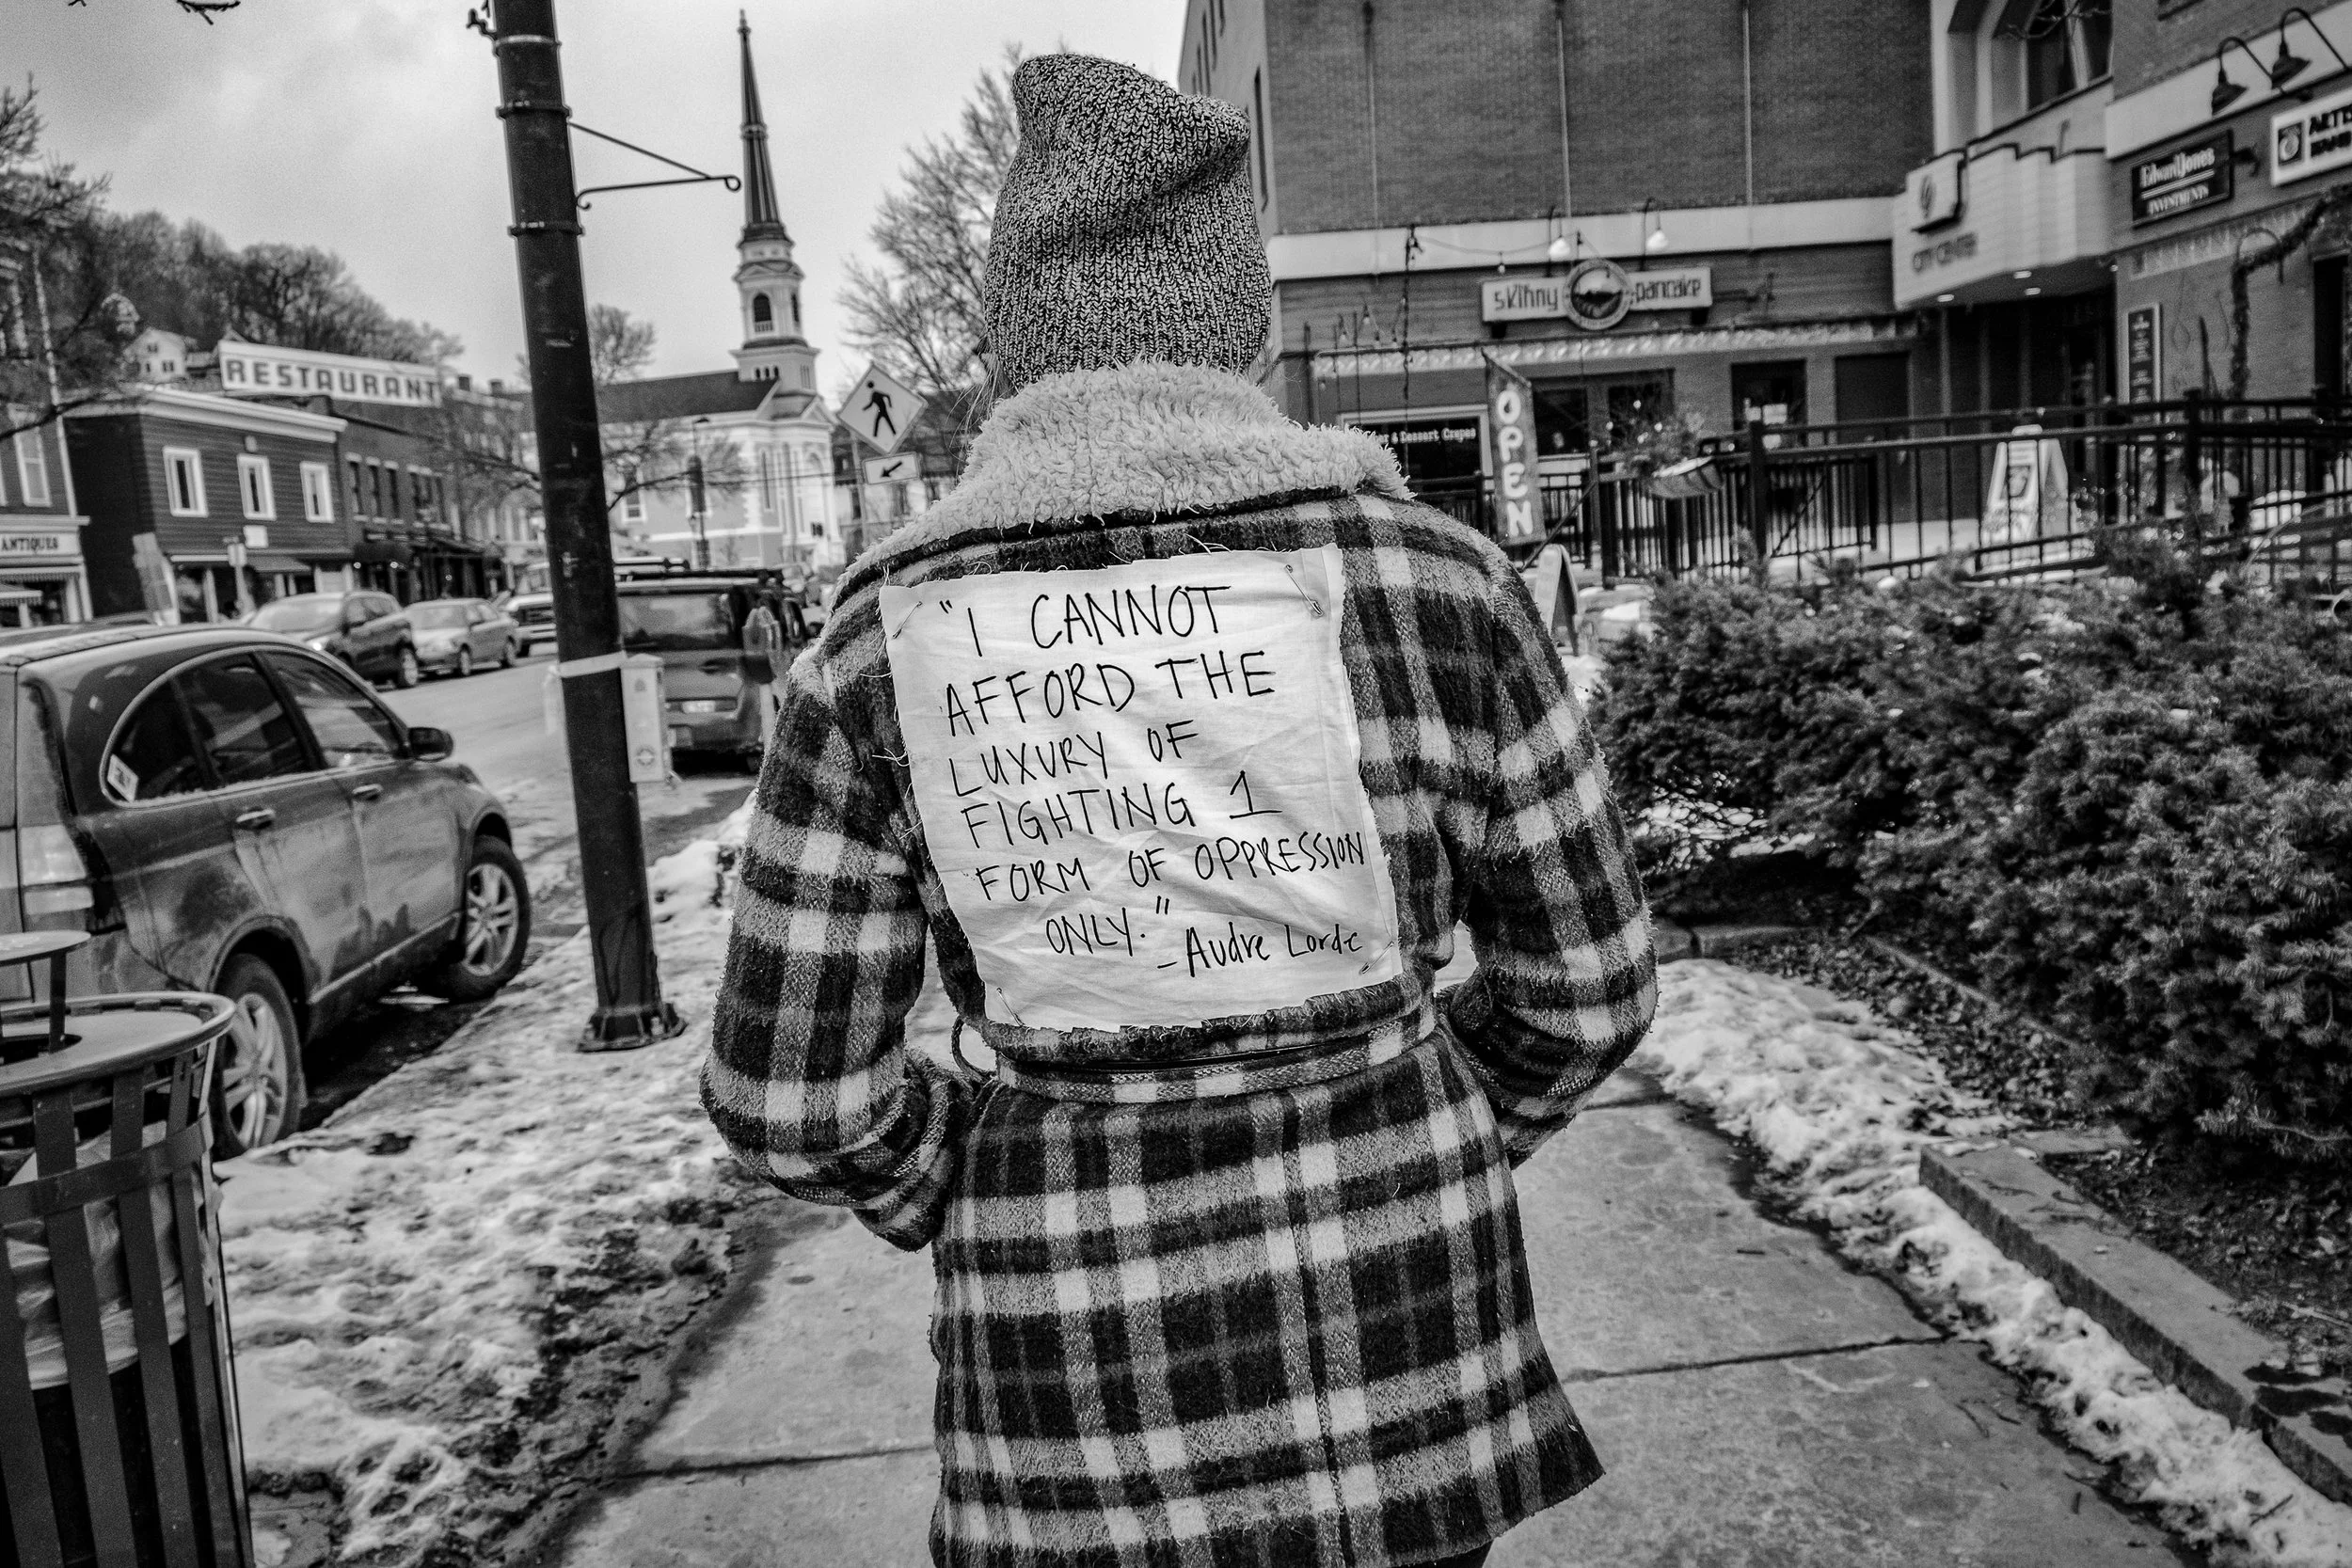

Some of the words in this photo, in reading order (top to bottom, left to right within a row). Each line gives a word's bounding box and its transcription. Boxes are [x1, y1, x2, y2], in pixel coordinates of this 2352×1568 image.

[1635, 275, 1701, 303] pancake
[226, 358, 439, 402] RESTAURANT
[1400, 430, 1439, 444] Dessert
[1441, 427, 1476, 443] Crepes
[1497, 389, 1534, 538] OPEN
[1, 536, 58, 554] ANTIQUES
[1030, 584, 1231, 649] CANNOT
[945, 662, 1136, 736] AFFORD
[1154, 650, 1276, 699] THE
[948, 731, 1109, 797] LUXURY
[1147, 720, 1200, 763] OF
[960, 782, 1197, 848] FIGHTING
[1229, 769, 1283, 819] 1
[975, 858, 1091, 902] FORM
[1128, 847, 1167, 888] OF
[1194, 831, 1365, 881] OPPRESSION
[1284, 923, 1363, 958] Lorde
